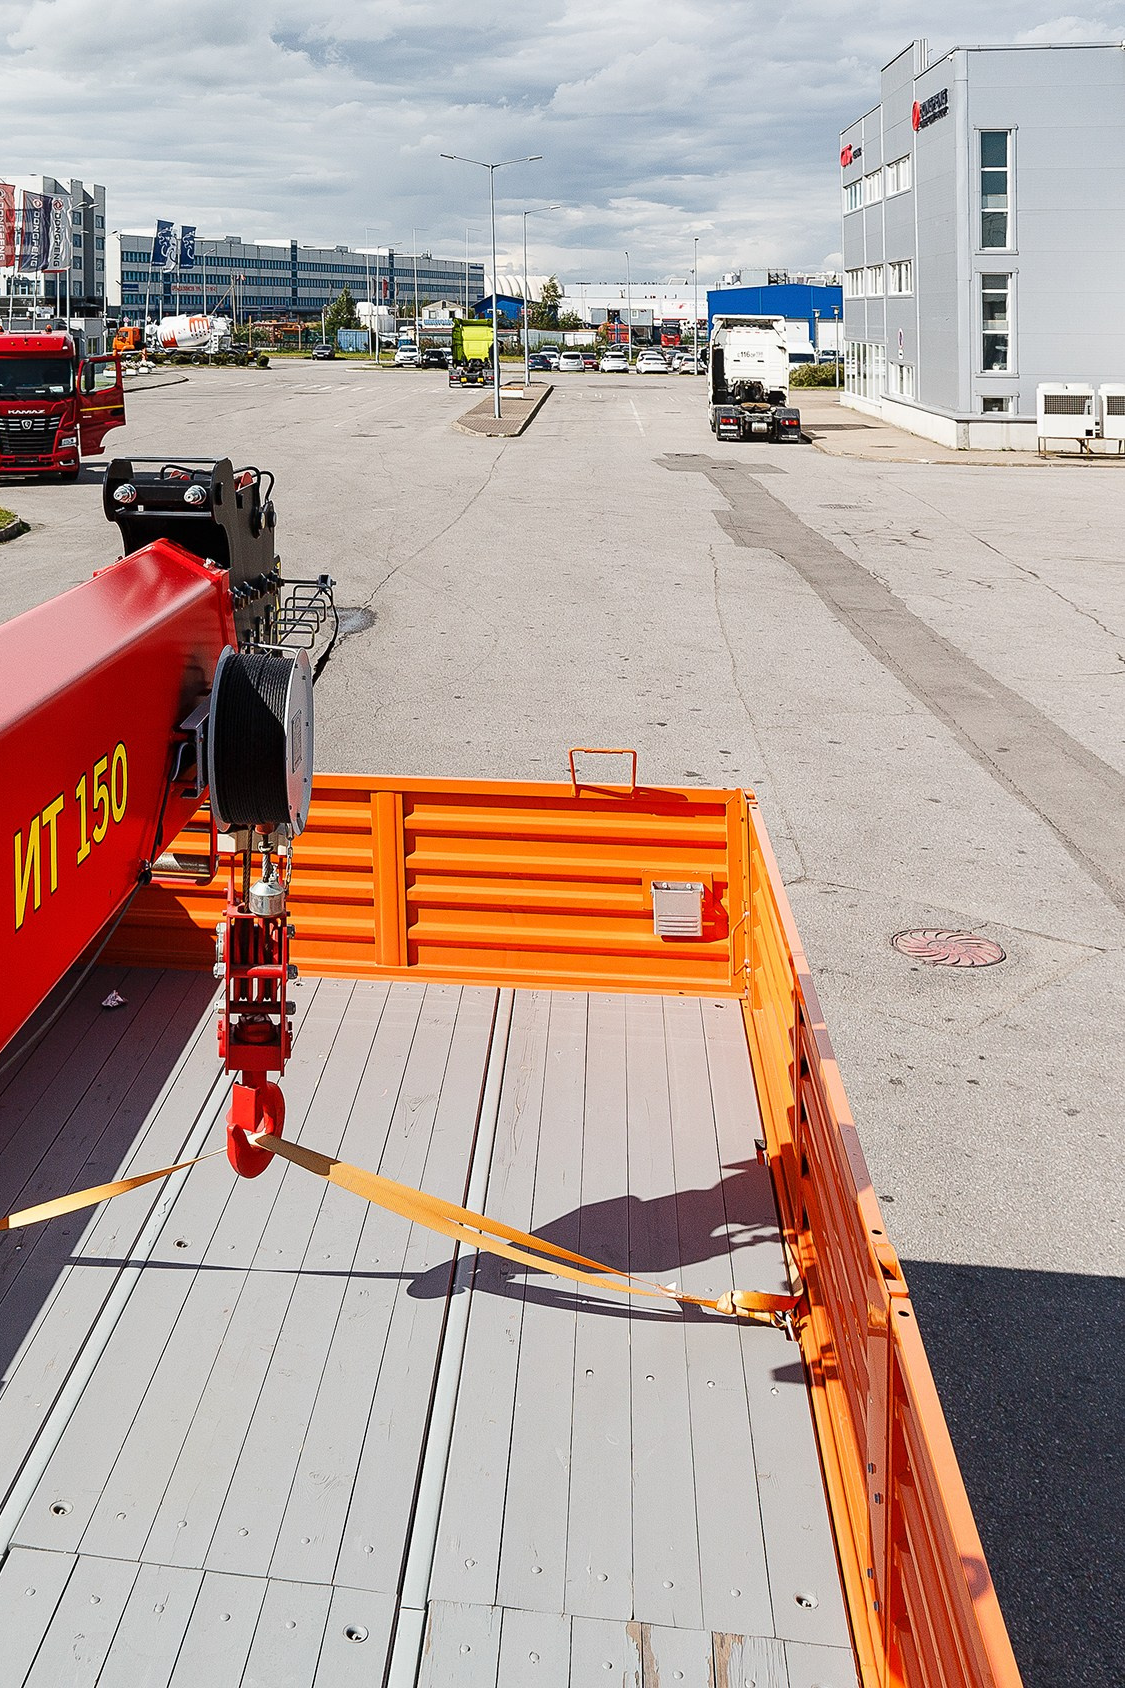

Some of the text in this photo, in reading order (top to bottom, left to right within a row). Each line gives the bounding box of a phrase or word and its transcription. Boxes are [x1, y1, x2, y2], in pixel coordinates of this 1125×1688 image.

[30, 211, 40, 267] DONGFENG
[12, 793, 64, 934] ИТ
[75, 739, 129, 867] 150
